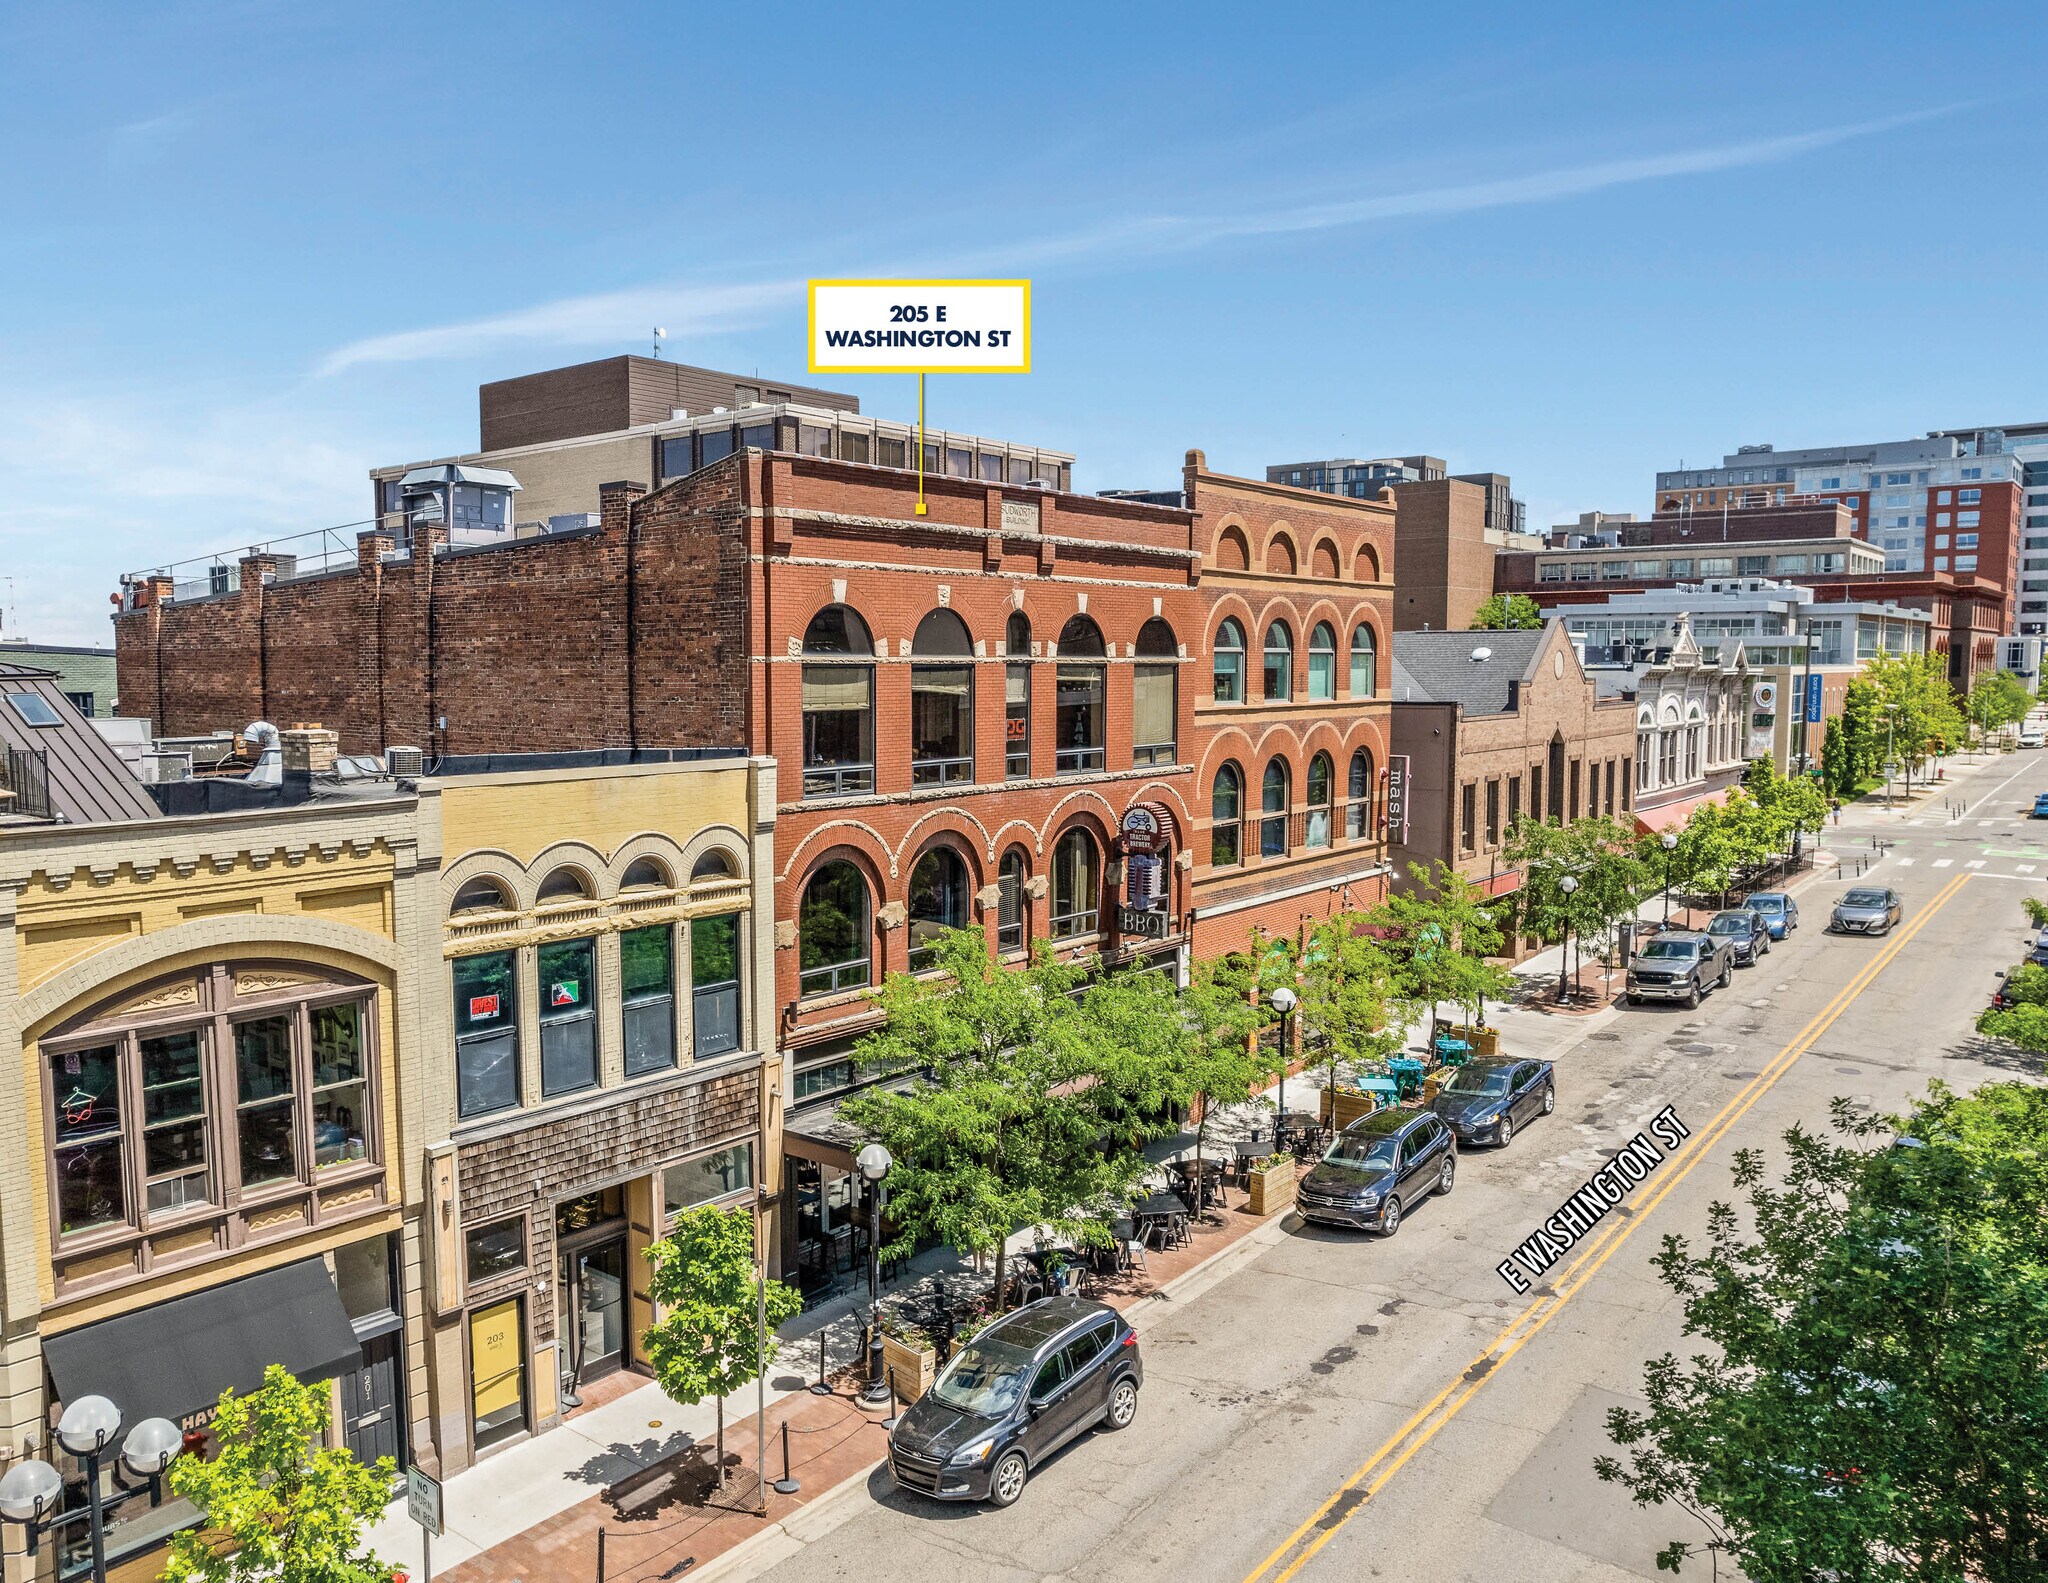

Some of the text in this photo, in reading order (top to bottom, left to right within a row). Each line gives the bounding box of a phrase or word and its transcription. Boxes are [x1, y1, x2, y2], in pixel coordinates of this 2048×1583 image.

[1389, 770, 1403, 829] mash
[1129, 833, 1151, 842] TRACTOR
[1123, 912, 1160, 935] BBQ
[487, 1332, 505, 1345] 203
[417, 1480, 428, 1494] NO
[414, 1491, 432, 1512] TURN
[411, 1504, 436, 1528] ON RED
